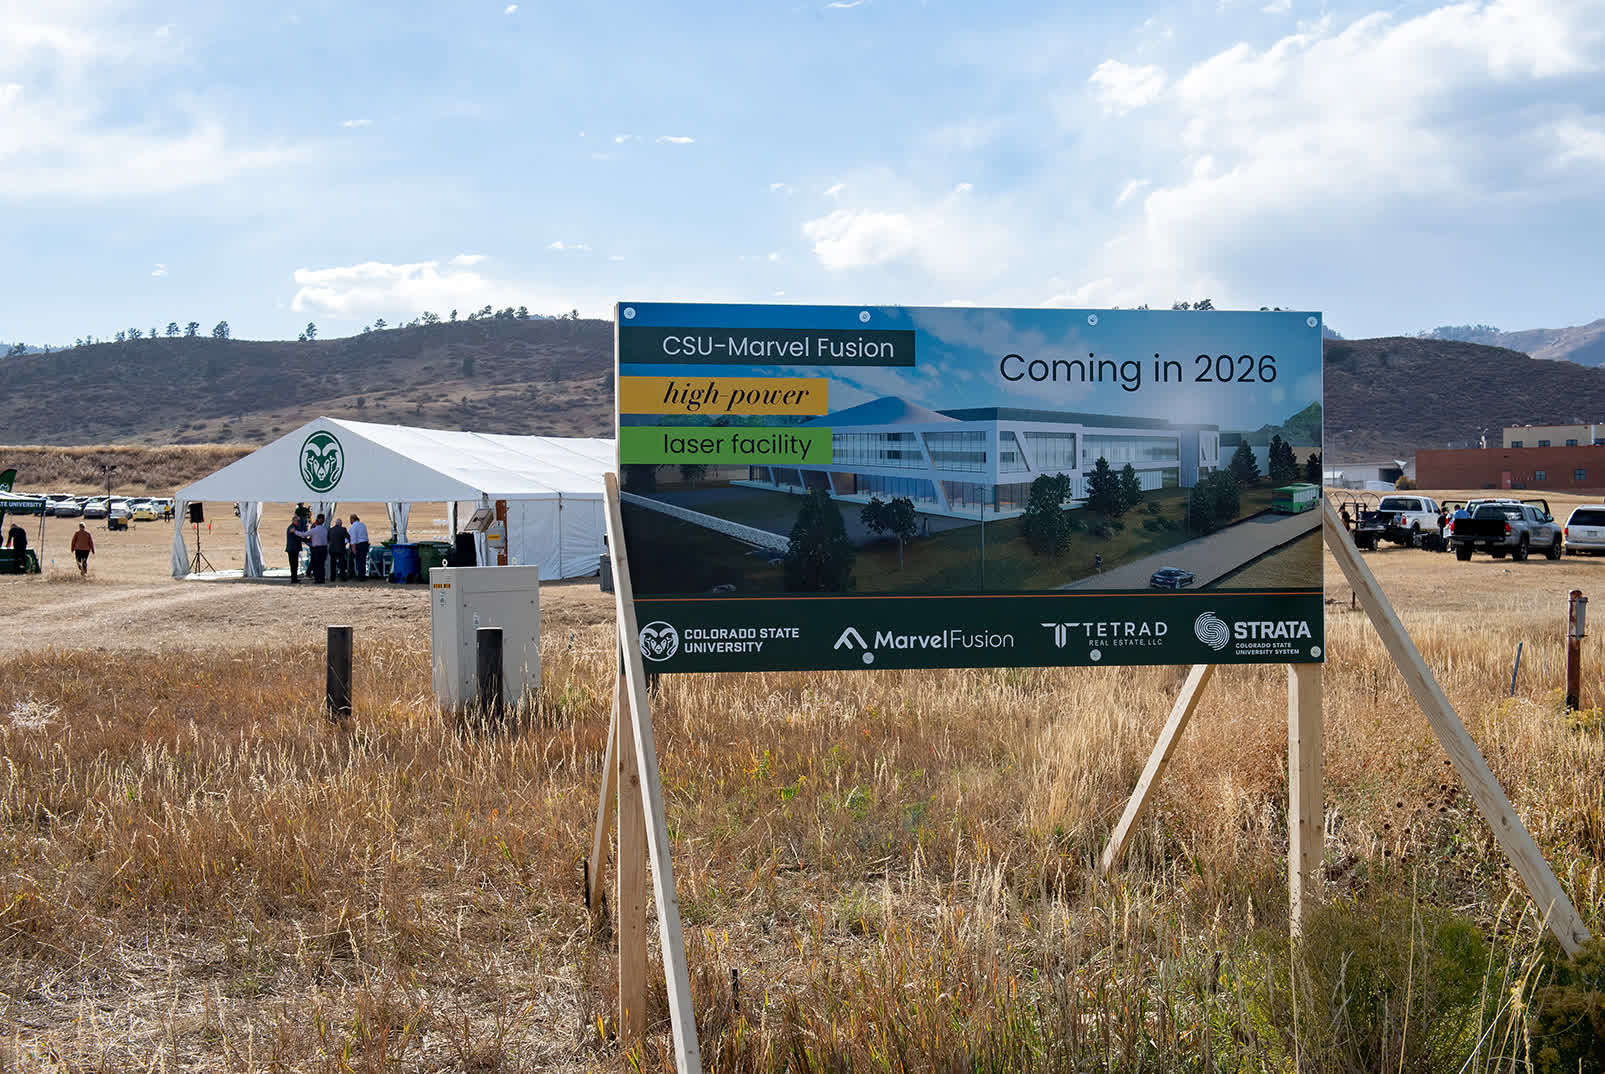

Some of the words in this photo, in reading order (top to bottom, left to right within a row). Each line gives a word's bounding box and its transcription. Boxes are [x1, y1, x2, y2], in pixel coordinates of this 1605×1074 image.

[662, 335, 809, 357] CSU-Marvel
[817, 336, 894, 358] Fusion
[1000, 353, 1142, 392] Coming
[1154, 353, 1182, 383] in
[1194, 354, 1278, 384] 2026
[663, 381, 810, 412] high-power
[664, 434, 725, 455] laser
[730, 433, 813, 461] facility
[684, 629, 757, 640] COLORADO
[759, 627, 800, 639] STATE
[1082, 621, 1168, 637] TETRAD
[1235, 621, 1312, 640] STRATA
[684, 641, 764, 654] UNIVERSITY
[1088, 639, 1109, 647] REAL
[1147, 638, 1163, 646] LLC
[1274, 648, 1300, 656] SYSTEM
